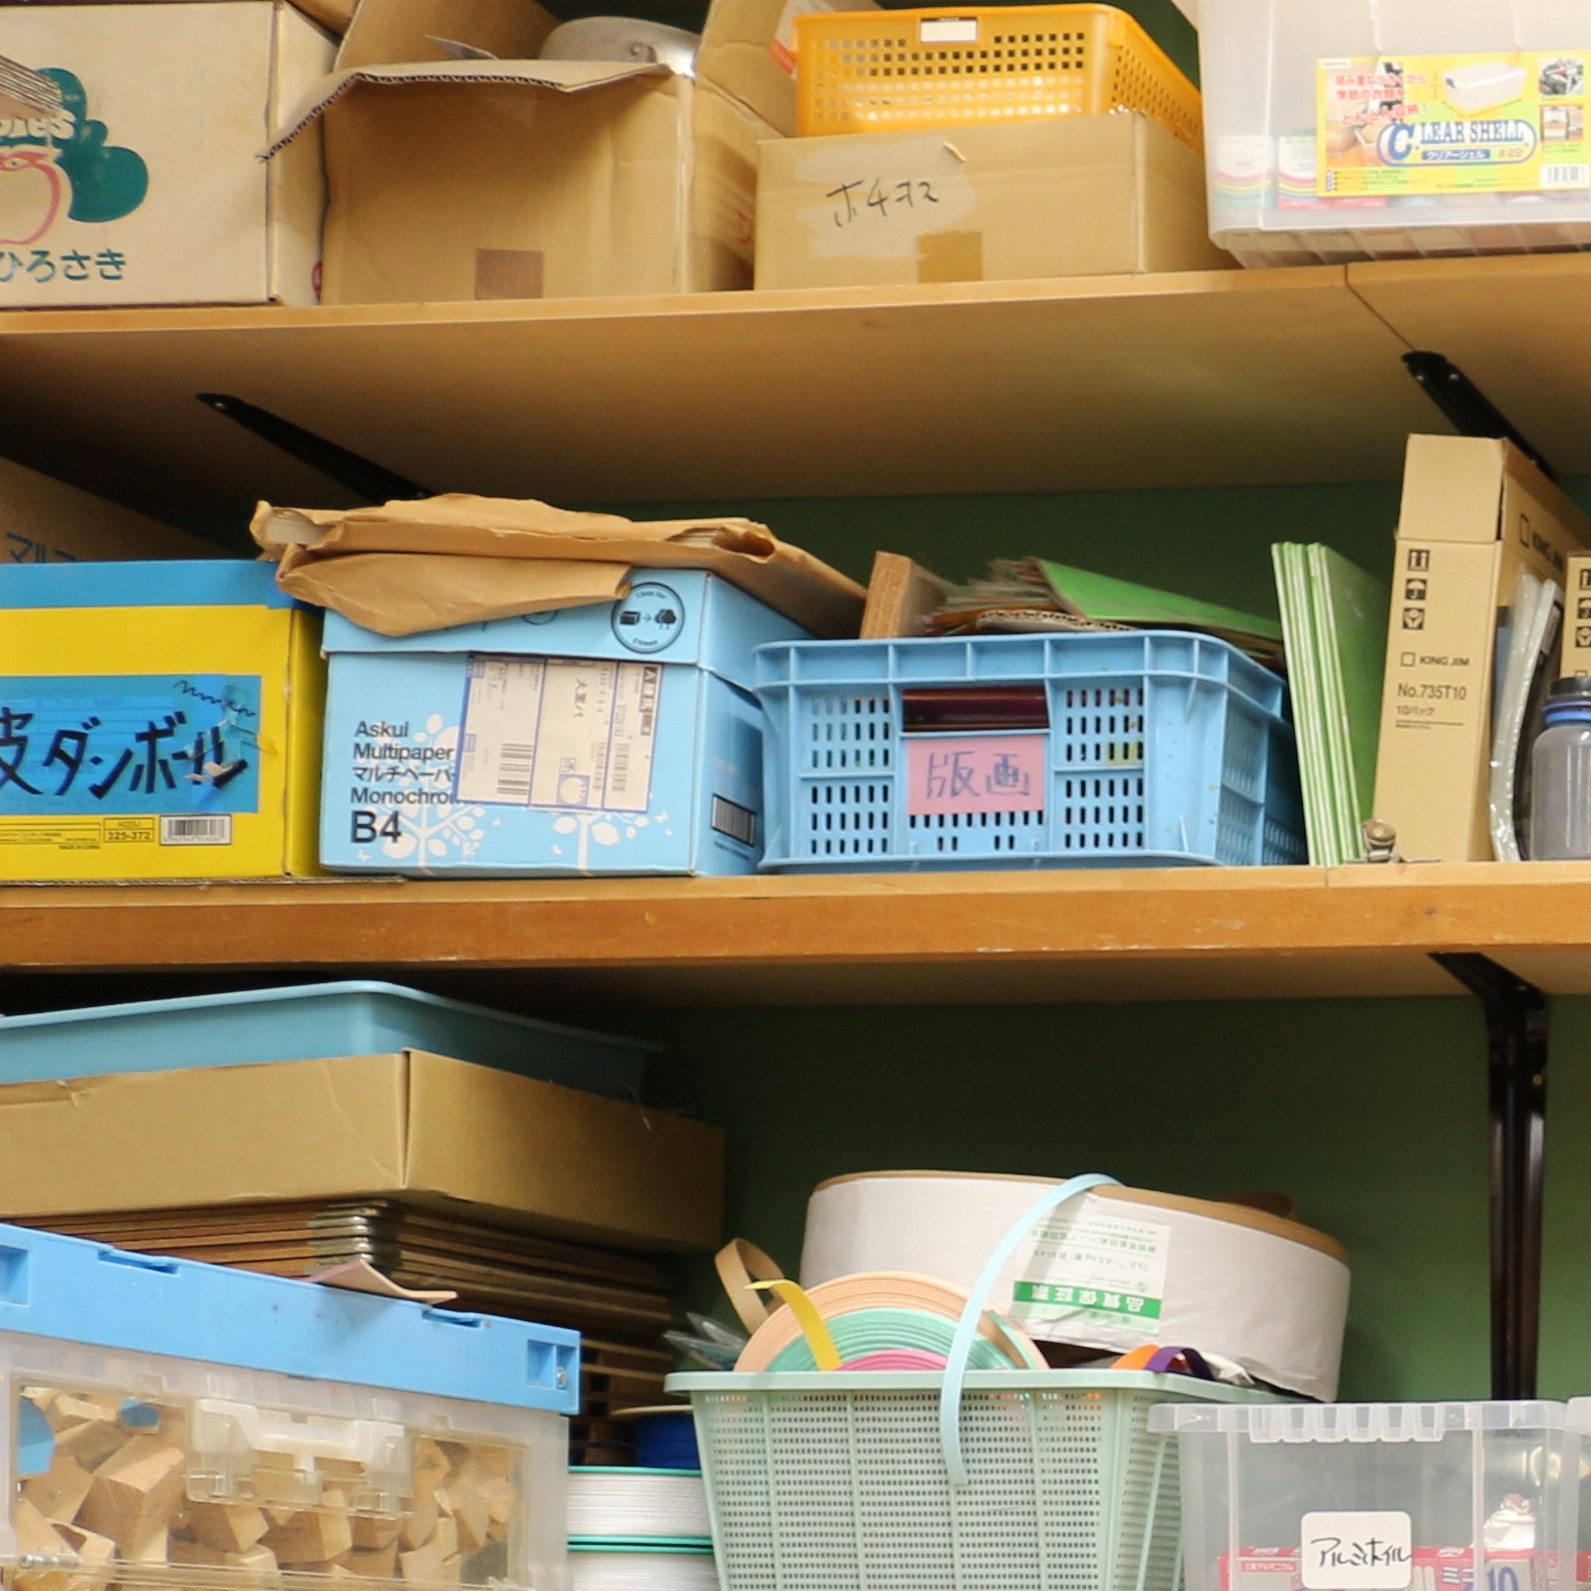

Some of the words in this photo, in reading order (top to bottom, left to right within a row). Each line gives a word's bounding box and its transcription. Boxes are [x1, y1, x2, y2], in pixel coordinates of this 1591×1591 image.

[1418, 656, 1446, 667] KING
[1447, 657, 1471, 667] JIM
[1396, 682, 1468, 700] No.735T10
[354, 720, 409, 740] Askul
[353, 742, 455, 763] Multipaper
[352, 766, 456, 782] マルチペーパ
[926, 750, 1031, 800] 版画
[107, 831, 152, 841] 325-372
[350, 810, 402, 844] B4
[1310, 1537, 1412, 1567] アルミホイル
